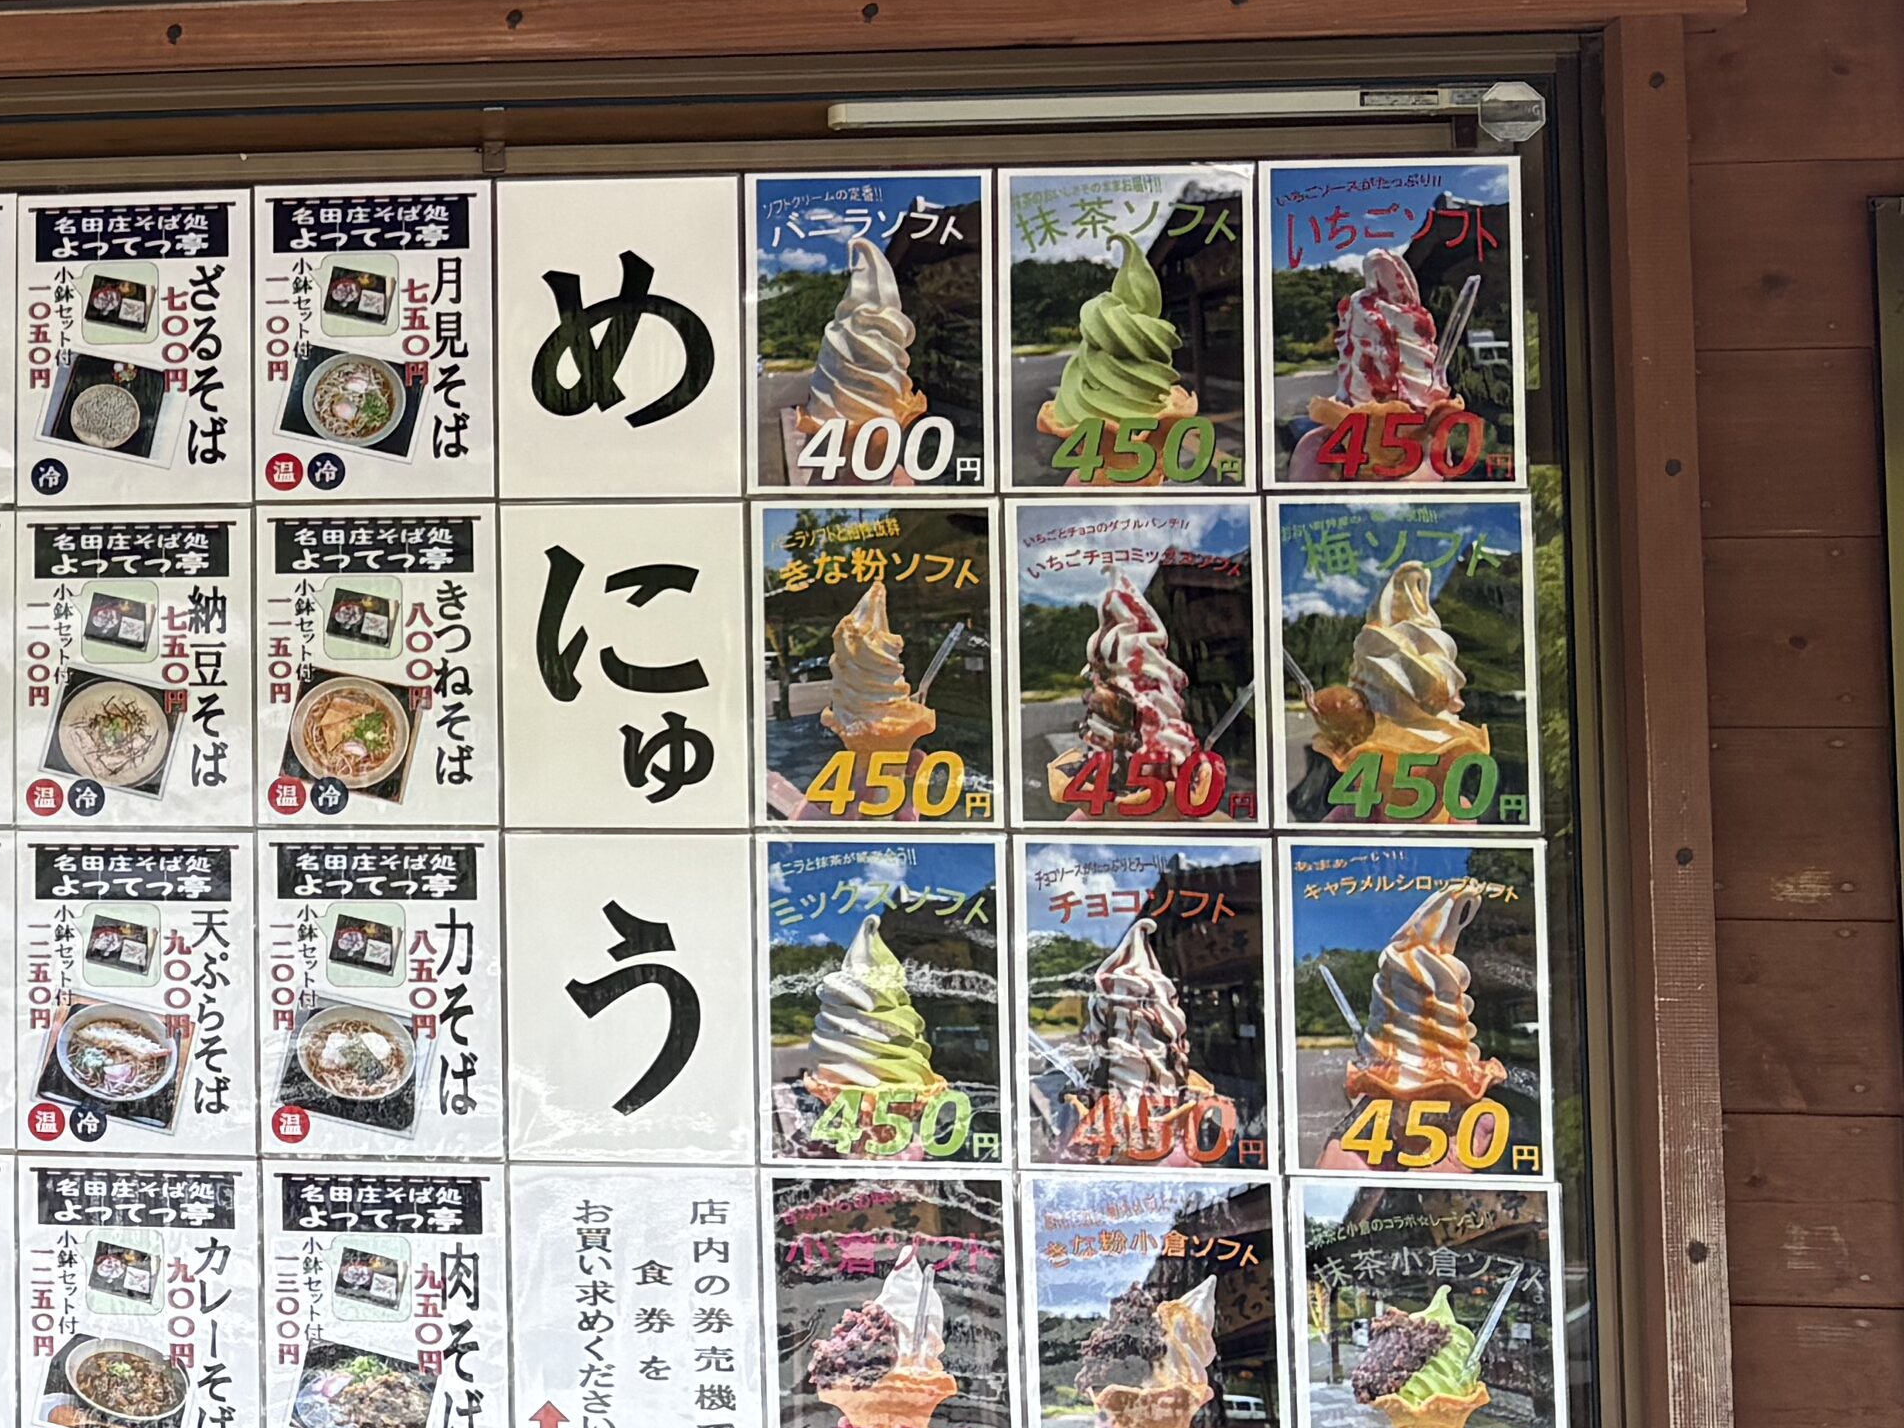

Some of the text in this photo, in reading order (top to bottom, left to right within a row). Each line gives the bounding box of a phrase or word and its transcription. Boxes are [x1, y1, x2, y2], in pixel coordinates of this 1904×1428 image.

[292, 207, 449, 225] 名田庄そば処
[772, 208, 964, 248] バニラソフト
[1016, 197, 1238, 253] 抹茶ソフト
[1286, 203, 1498, 270] いちごソフト
[54, 268, 74, 366] 小鉢セット付
[188, 265, 226, 465] ざるそば
[430, 257, 470, 458] 月見そば
[53, 532, 210, 550] 名田庄そば処
[780, 547, 980, 592] きな粉ソフト
[1301, 526, 1501, 583] 梅ソフト
[295, 580, 315, 682] 小鉢セット付
[188, 586, 228, 787] 納豆そば
[432, 580, 473, 785] きつねそば
[54, 855, 212, 873] 名田庄そば処
[770, 881, 989, 925] ミックスソフト
[1049, 888, 1236, 924] チョコソフト
[298, 905, 319, 1008] 小鉢セット付
[192, 909, 231, 1115] 天ぷらそば
[435, 908, 479, 1116] 力そば
[301, 1185, 462, 1206] 名田庄そば処
[57, 1230, 78, 1335] 小鉢セット付
[1313, 1245, 1544, 1292] 抹茶小倉ソフト
[632, 1260, 675, 1380] 食券を
